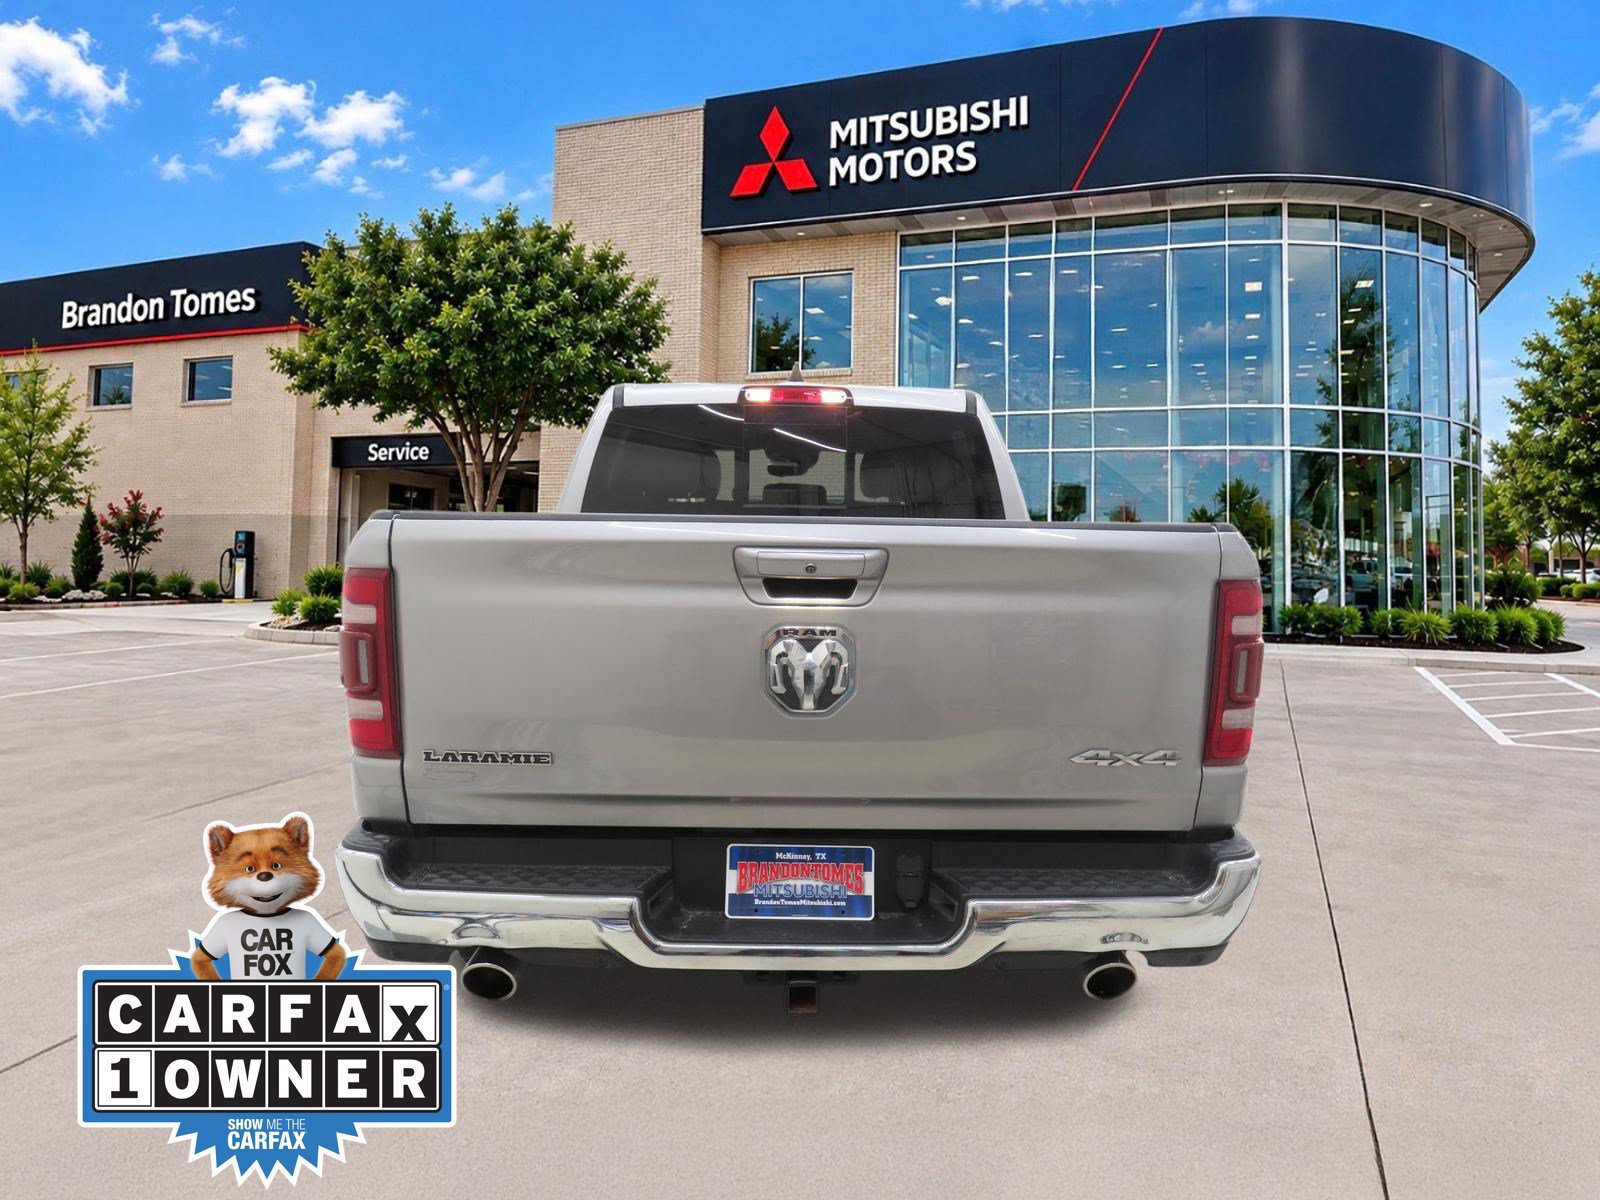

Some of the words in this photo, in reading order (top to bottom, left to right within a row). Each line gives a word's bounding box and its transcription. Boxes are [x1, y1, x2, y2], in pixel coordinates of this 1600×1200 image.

[829, 95, 1029, 149] MITSUBISHI
[828, 140, 977, 187] MOTORS
[61, 292, 165, 330] Brandon
[170, 287, 256, 318] Tomes
[367, 441, 430, 462] Service
[782, 628, 837, 637] RAM
[423, 750, 552, 765] LARAMIE
[775, 852, 813, 861] McKinney,
[753, 883, 848, 899] MITSUBISHI
[754, 898, 847, 907] BrandonTomesMitsubishi.com
